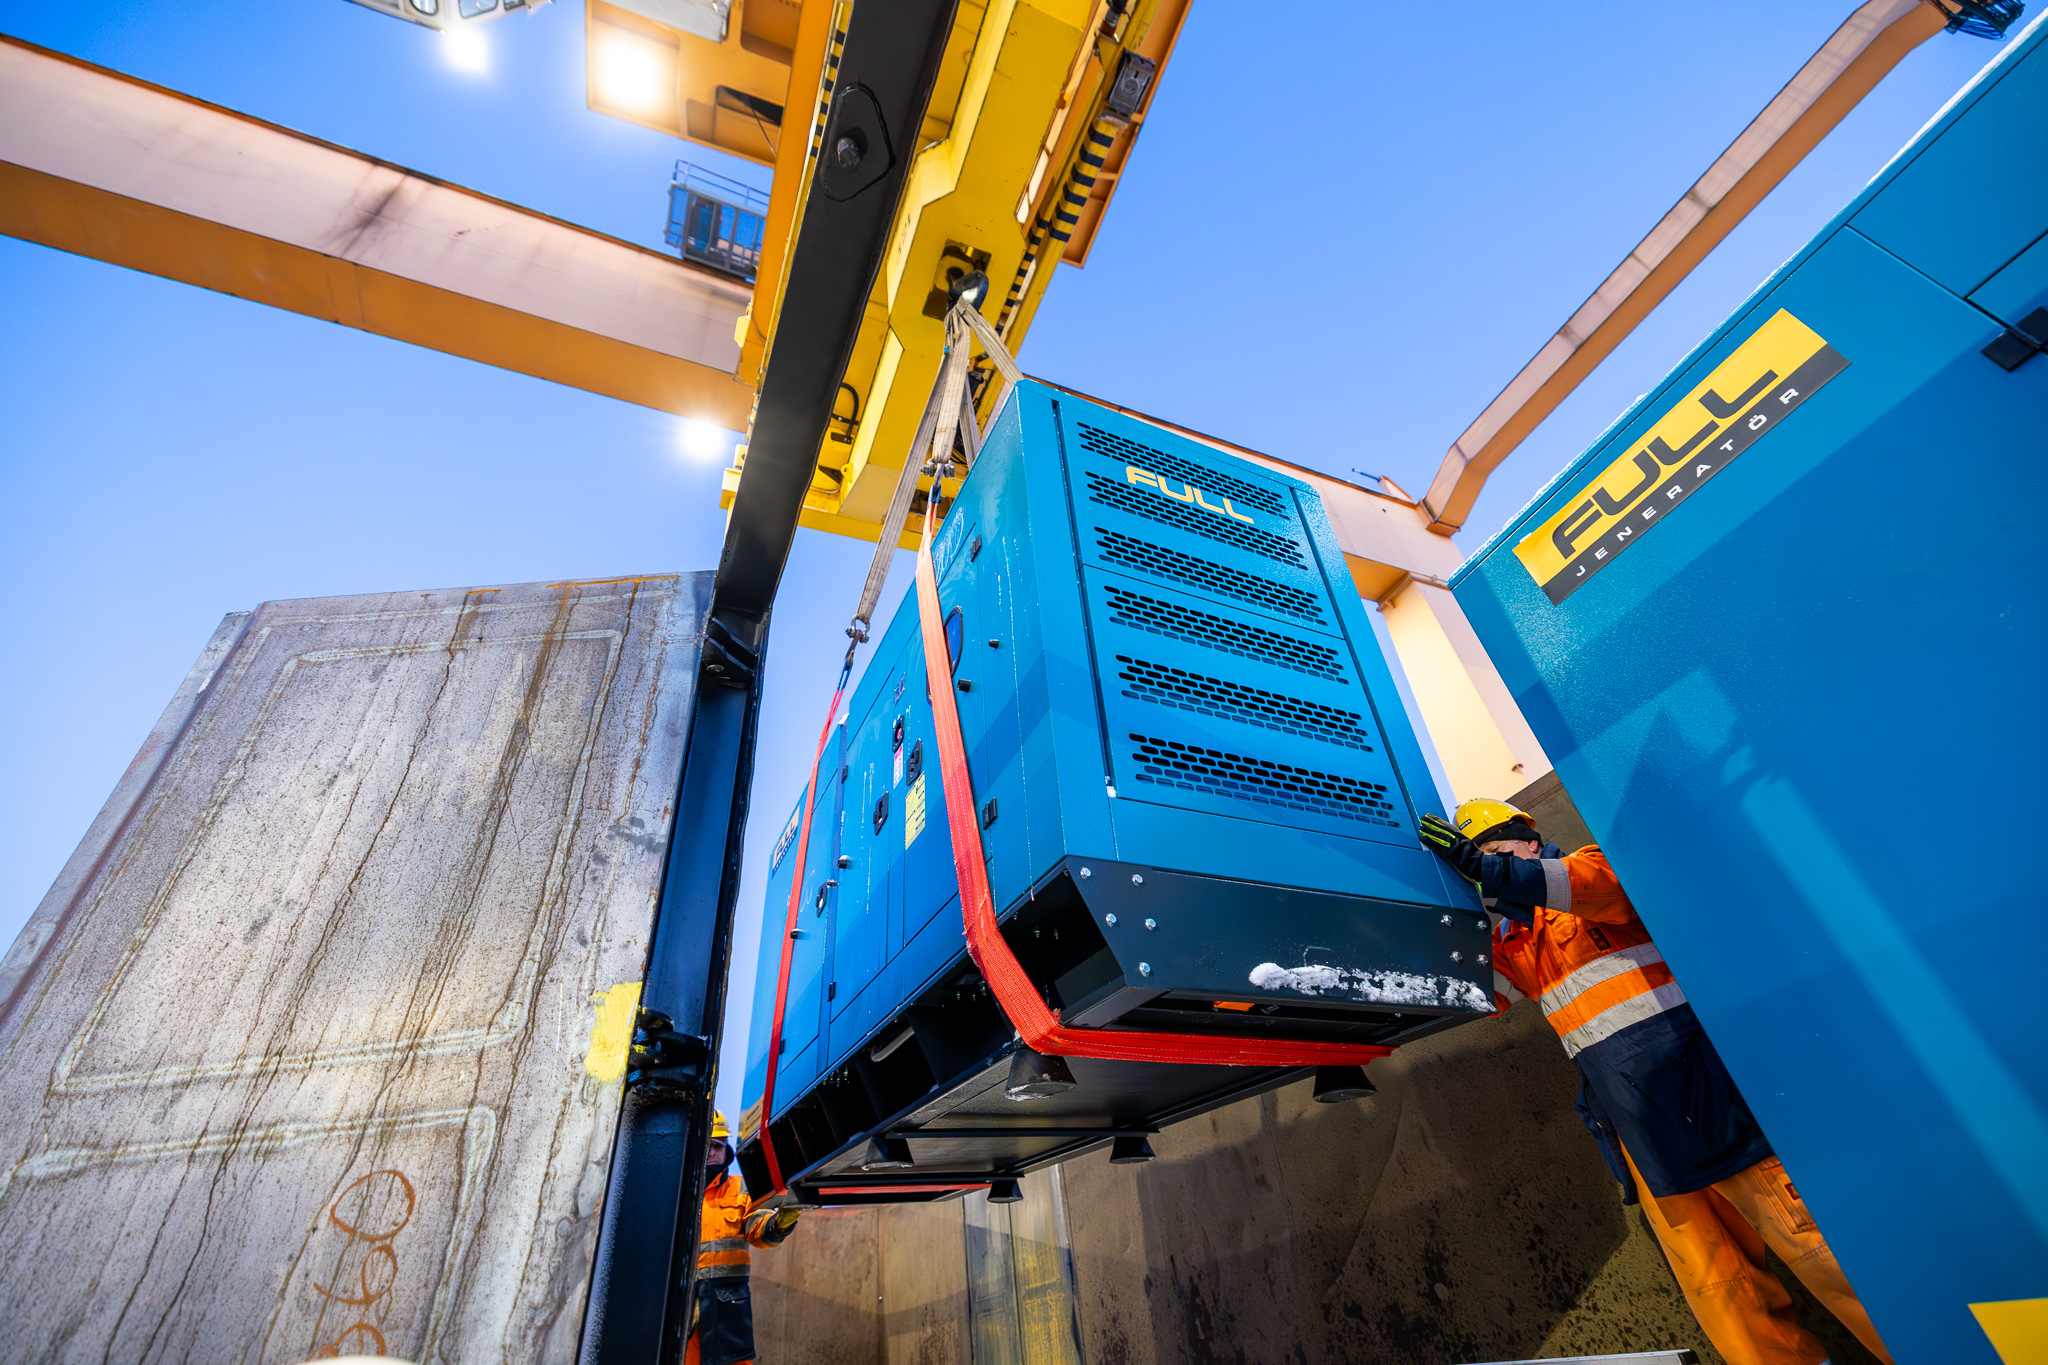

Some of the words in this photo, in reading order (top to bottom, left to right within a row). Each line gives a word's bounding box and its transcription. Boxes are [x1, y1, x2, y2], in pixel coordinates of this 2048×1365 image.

[1125, 465, 1255, 525] FULL
[1551, 369, 1779, 560] FULL
[1575, 388, 1800, 578] JENERATÖR
